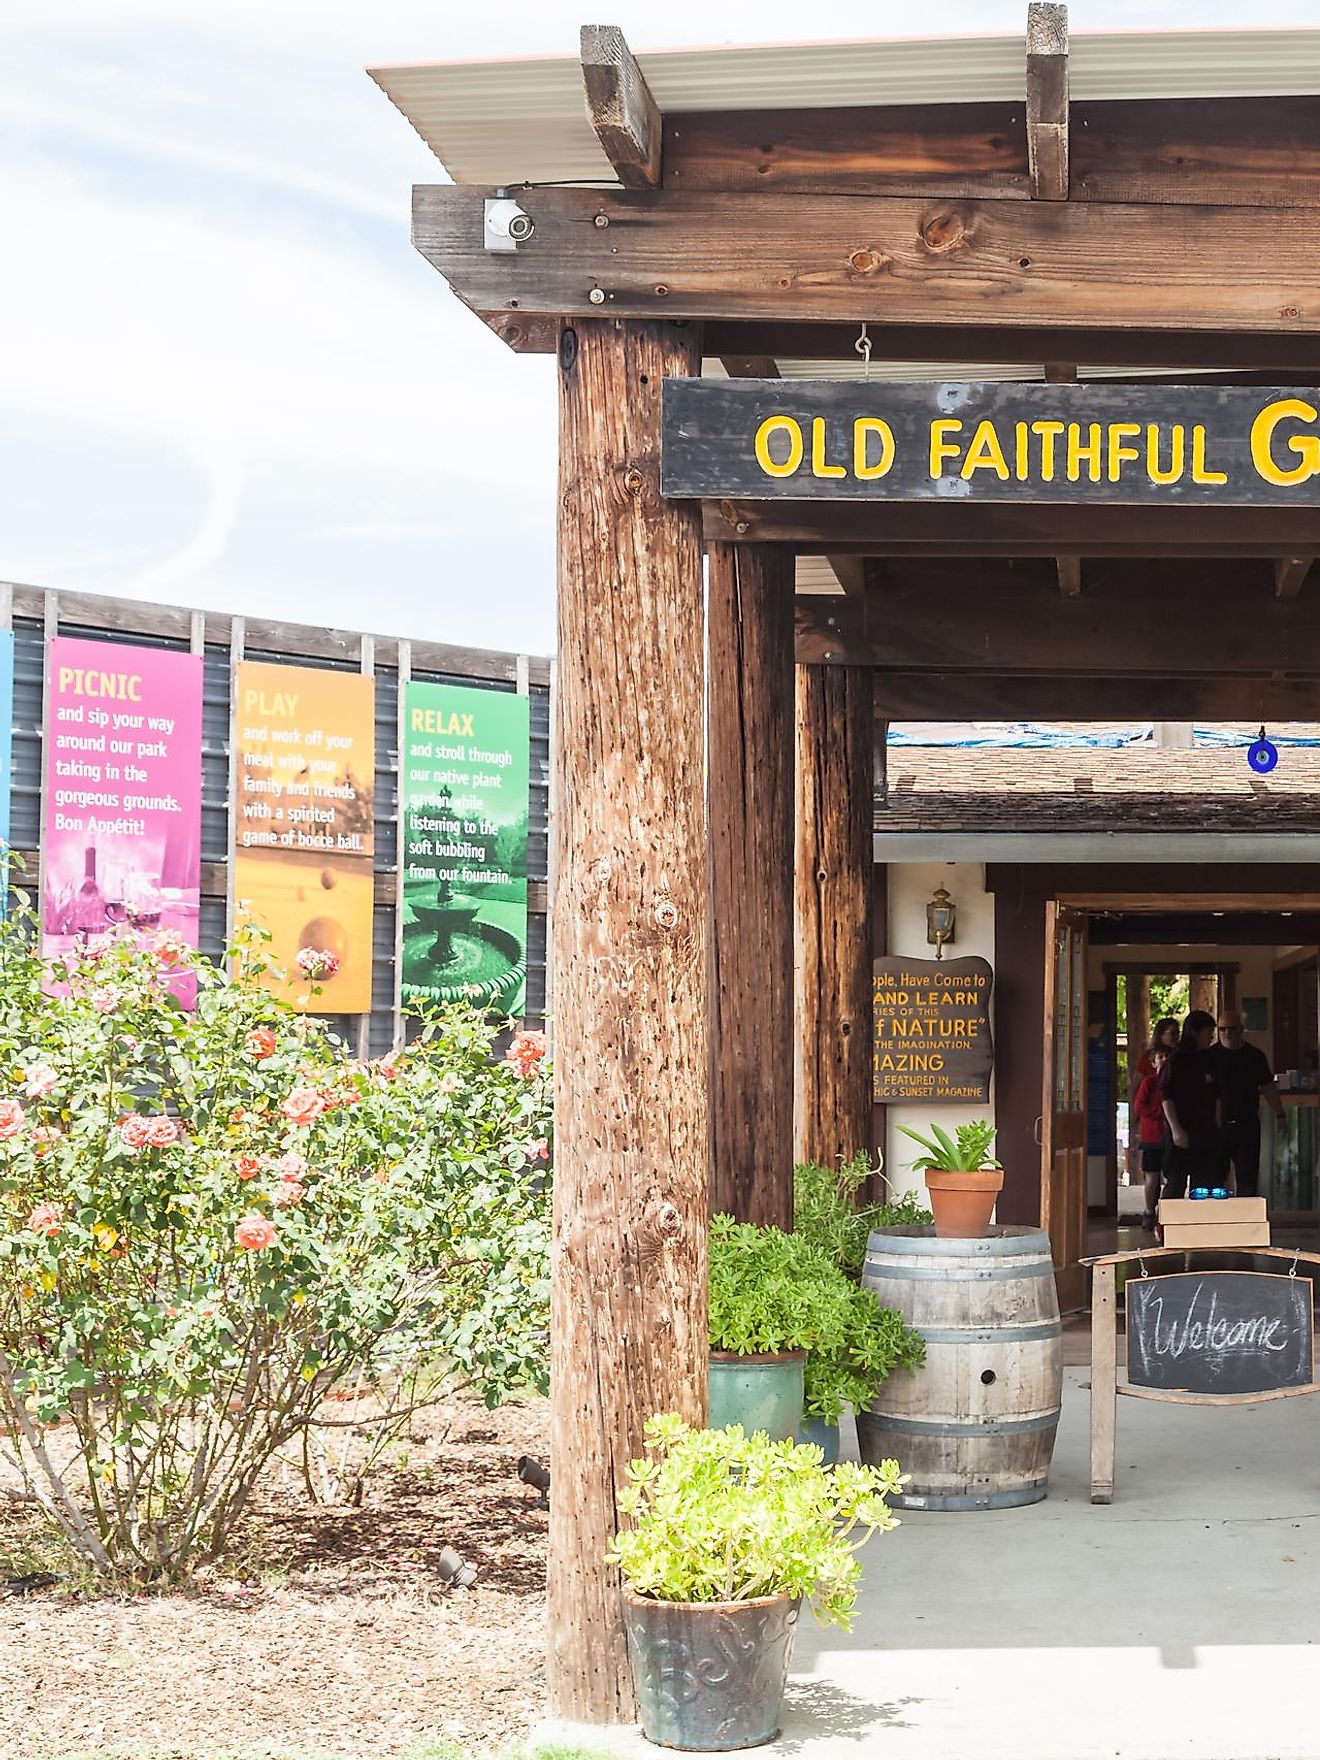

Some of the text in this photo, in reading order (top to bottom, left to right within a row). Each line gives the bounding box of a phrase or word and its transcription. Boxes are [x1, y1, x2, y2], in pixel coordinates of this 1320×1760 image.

[754, 415, 895, 479] OLD
[929, 420, 1227, 485] FAITHFUL
[58, 667, 142, 701] PICNIC
[245, 689, 298, 718] PLAY
[57, 705, 174, 735] and sip your way
[411, 708, 474, 737] RELAX
[56, 735, 167, 759] around our park
[243, 726, 354, 750] and work off your
[243, 752, 337, 774] meal with your
[410, 743, 512, 768] and stroll through
[56, 760, 147, 782] taking in the
[410, 768, 502, 789] our native plant
[243, 775, 355, 800] family and friends
[55, 789, 182, 811] gorgeous grounds.
[409, 794, 484, 810] garden while
[243, 802, 335, 823] with a spirited
[55, 813, 144, 836] Bon Appétit!
[409, 814, 498, 836] listening to the
[242, 831, 364, 850] game of bocce ball.
[409, 840, 485, 862] soft bubbling
[408, 863, 512, 885] from our fountain.
[900, 973, 930, 987] Have
[934, 973, 970, 987] Come
[974, 974, 986, 987] to
[873, 991, 978, 1006] AND LEARN
[900, 1008, 913, 1016] OF
[918, 1008, 939, 1016] THIS
[874, 1040, 972, 1049] THE IMAGINATION.
[885, 1075, 935, 1086] FEATURED
[938, 1075, 948, 1085] IN
[900, 1087, 933, 1097] SUNSET
[936, 1087, 982, 1097] MAGAZINE
[1150, 1280, 1288, 1359] Welcome
